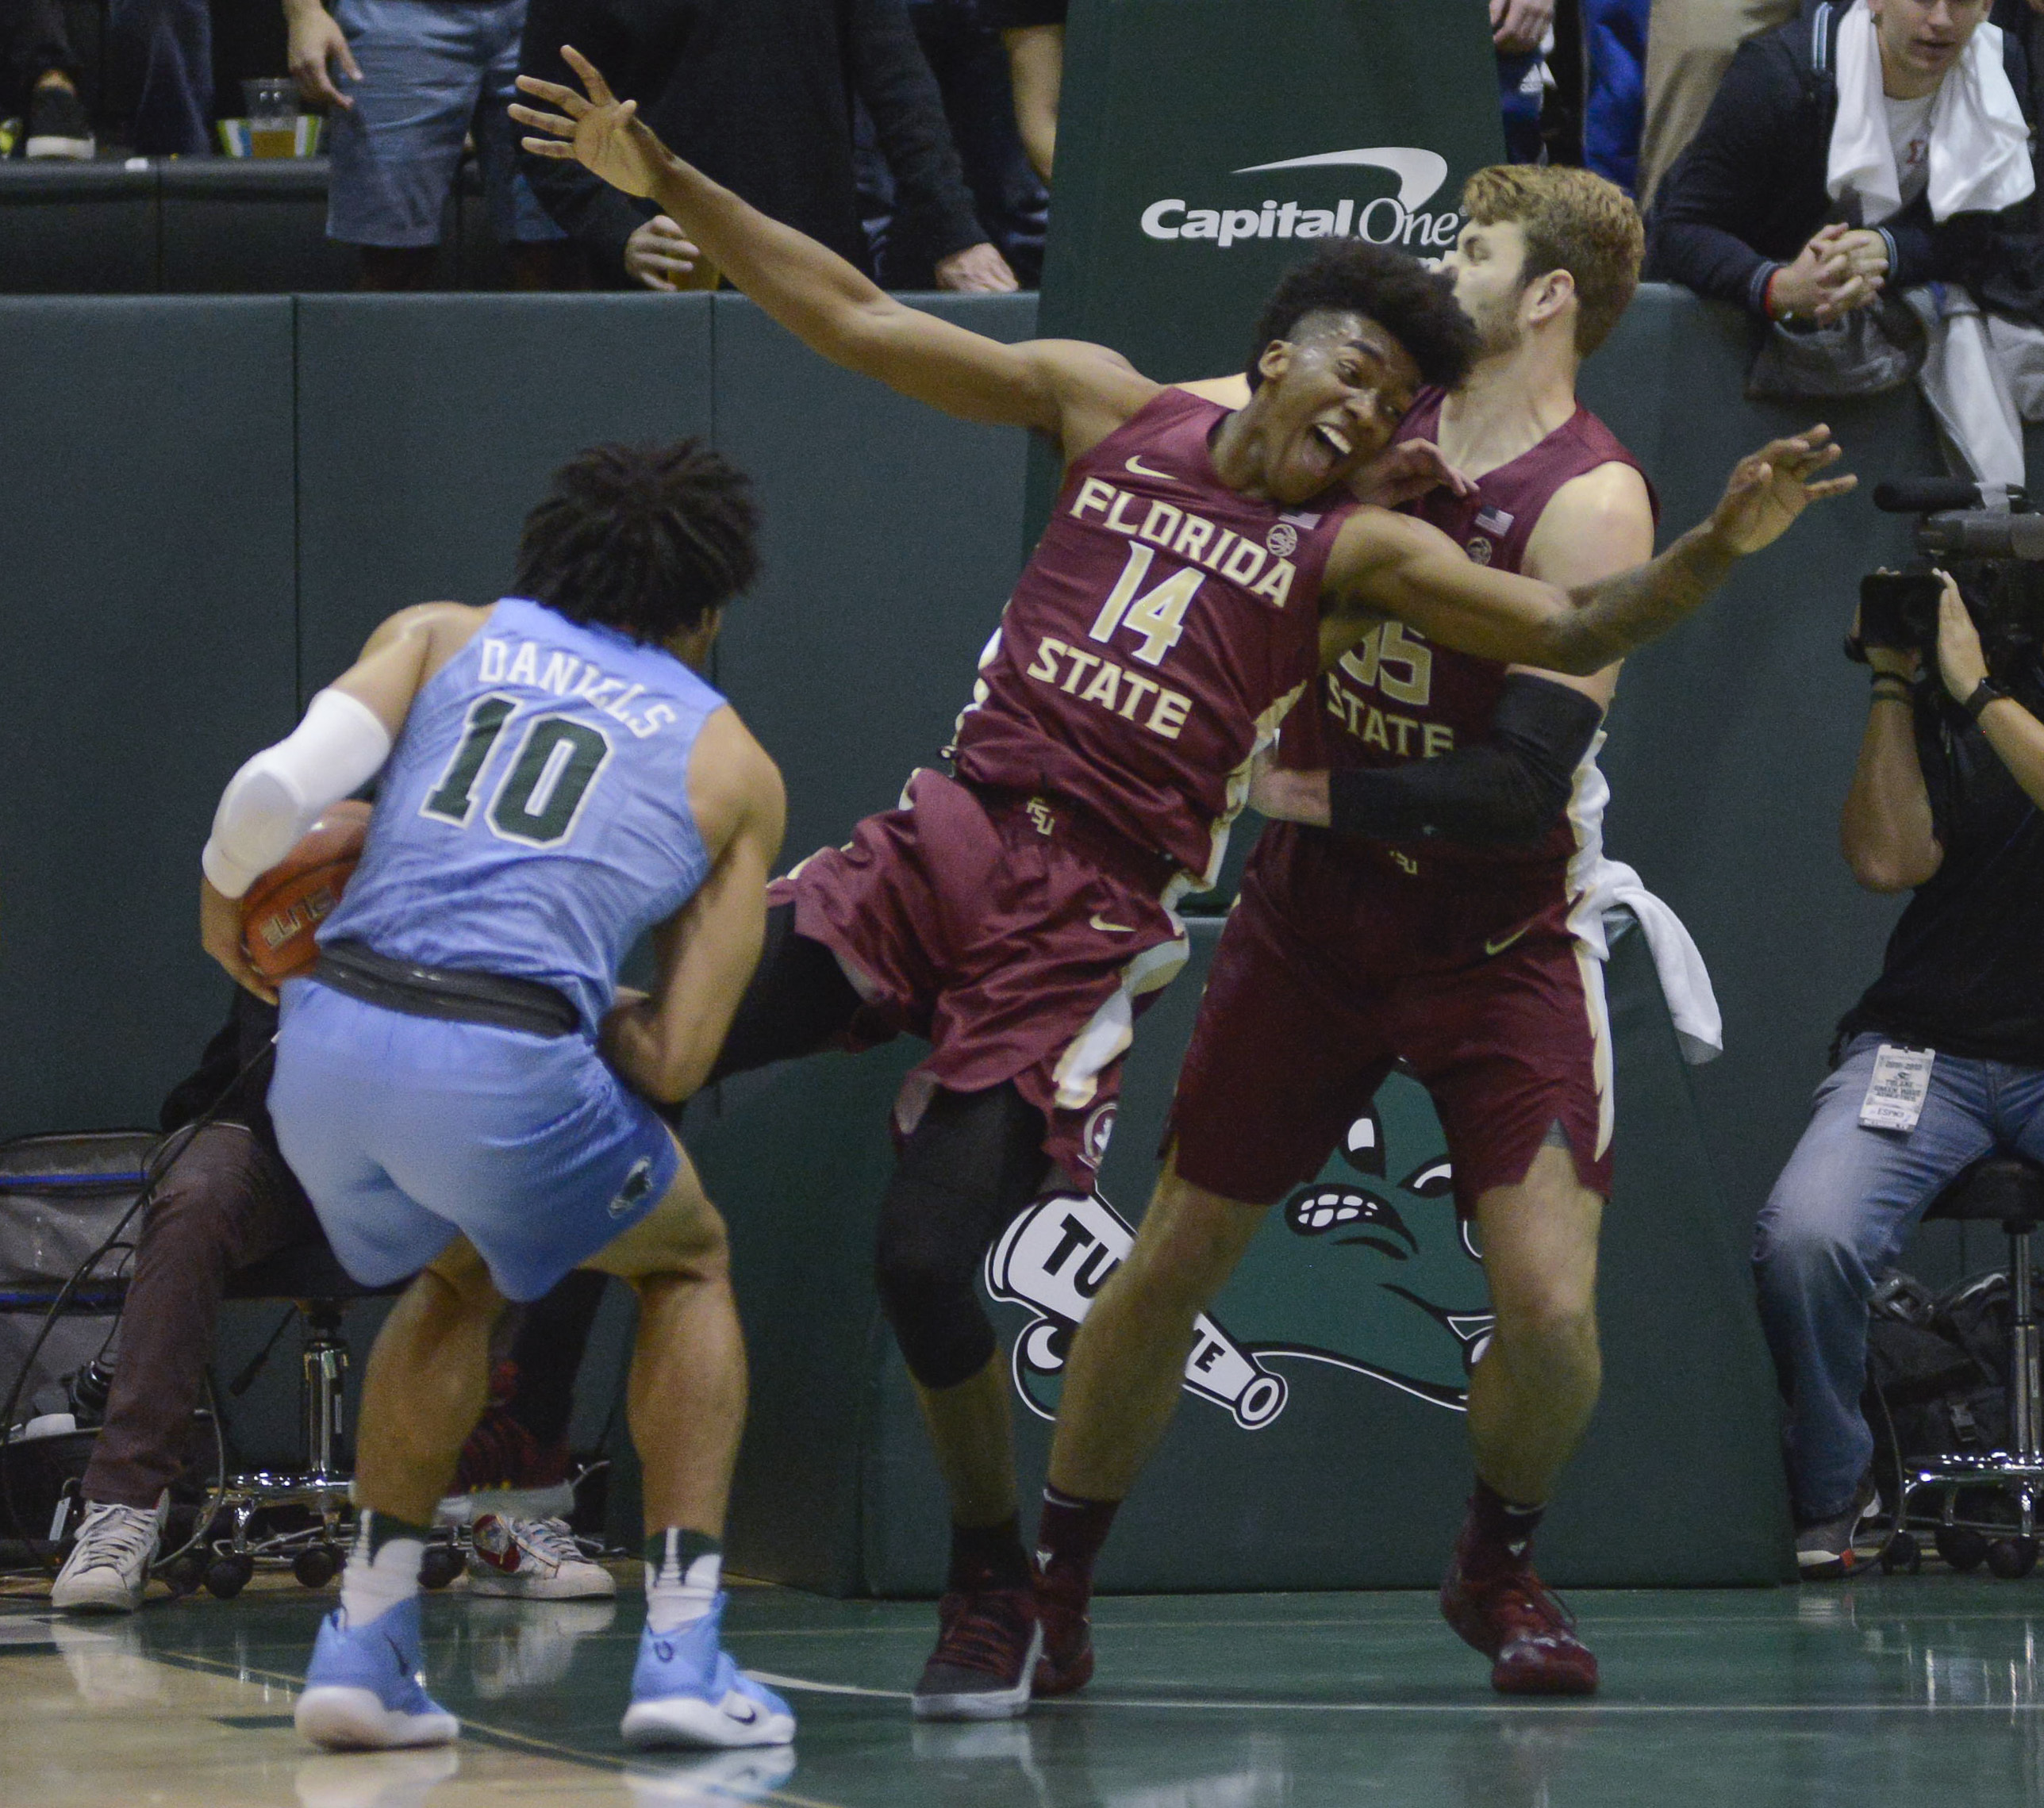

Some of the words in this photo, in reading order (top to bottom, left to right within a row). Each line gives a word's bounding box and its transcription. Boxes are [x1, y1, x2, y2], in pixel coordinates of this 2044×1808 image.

[1141, 198, 1354, 247] Capital
[1358, 197, 1458, 245] One
[1068, 476, 1297, 608] FLORIDA
[1088, 540, 1207, 666] 14
[1027, 636, 1193, 739] STATE
[1327, 671, 1454, 758] STATE
[418, 691, 615, 850] 10
